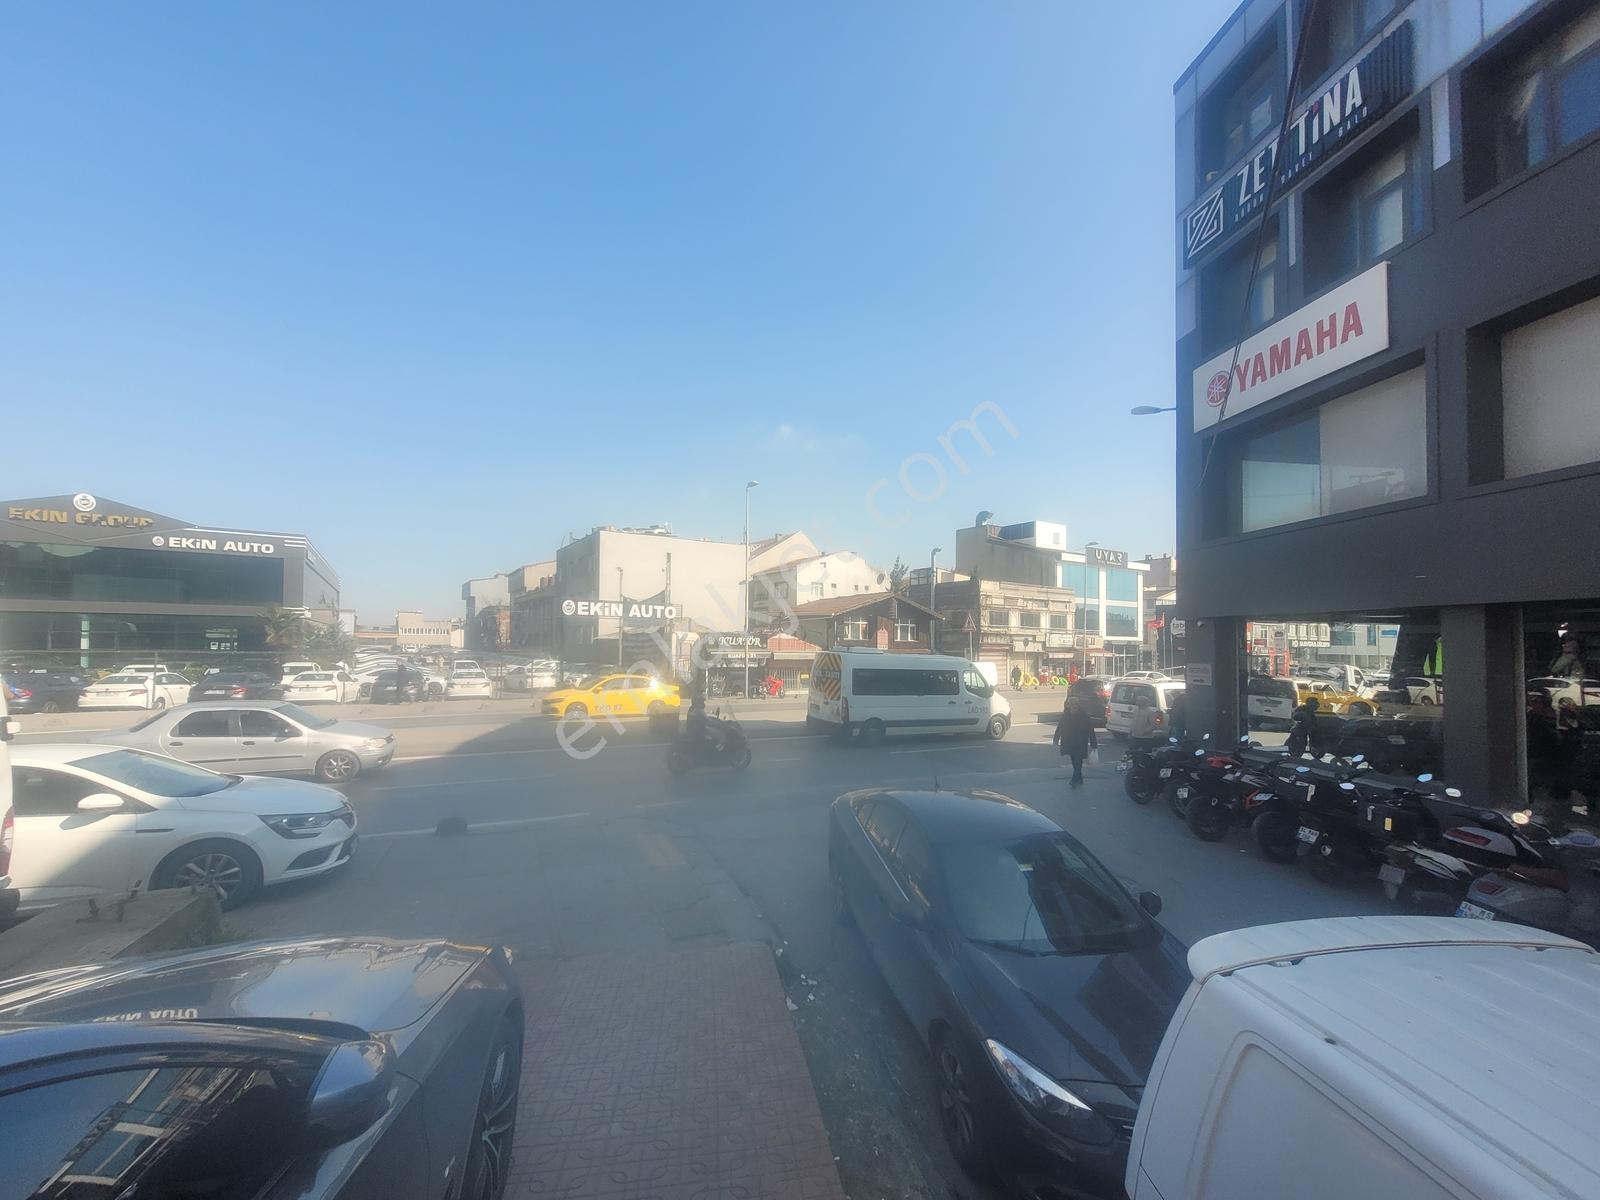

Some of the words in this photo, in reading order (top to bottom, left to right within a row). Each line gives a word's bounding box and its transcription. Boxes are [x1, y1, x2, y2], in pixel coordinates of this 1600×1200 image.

[1235, 301, 1364, 393] YAMAHA
[223, 540, 275, 554] AUTO
[628, 604, 677, 619] AUTO
[718, 635, 762, 648] KUAÖR
